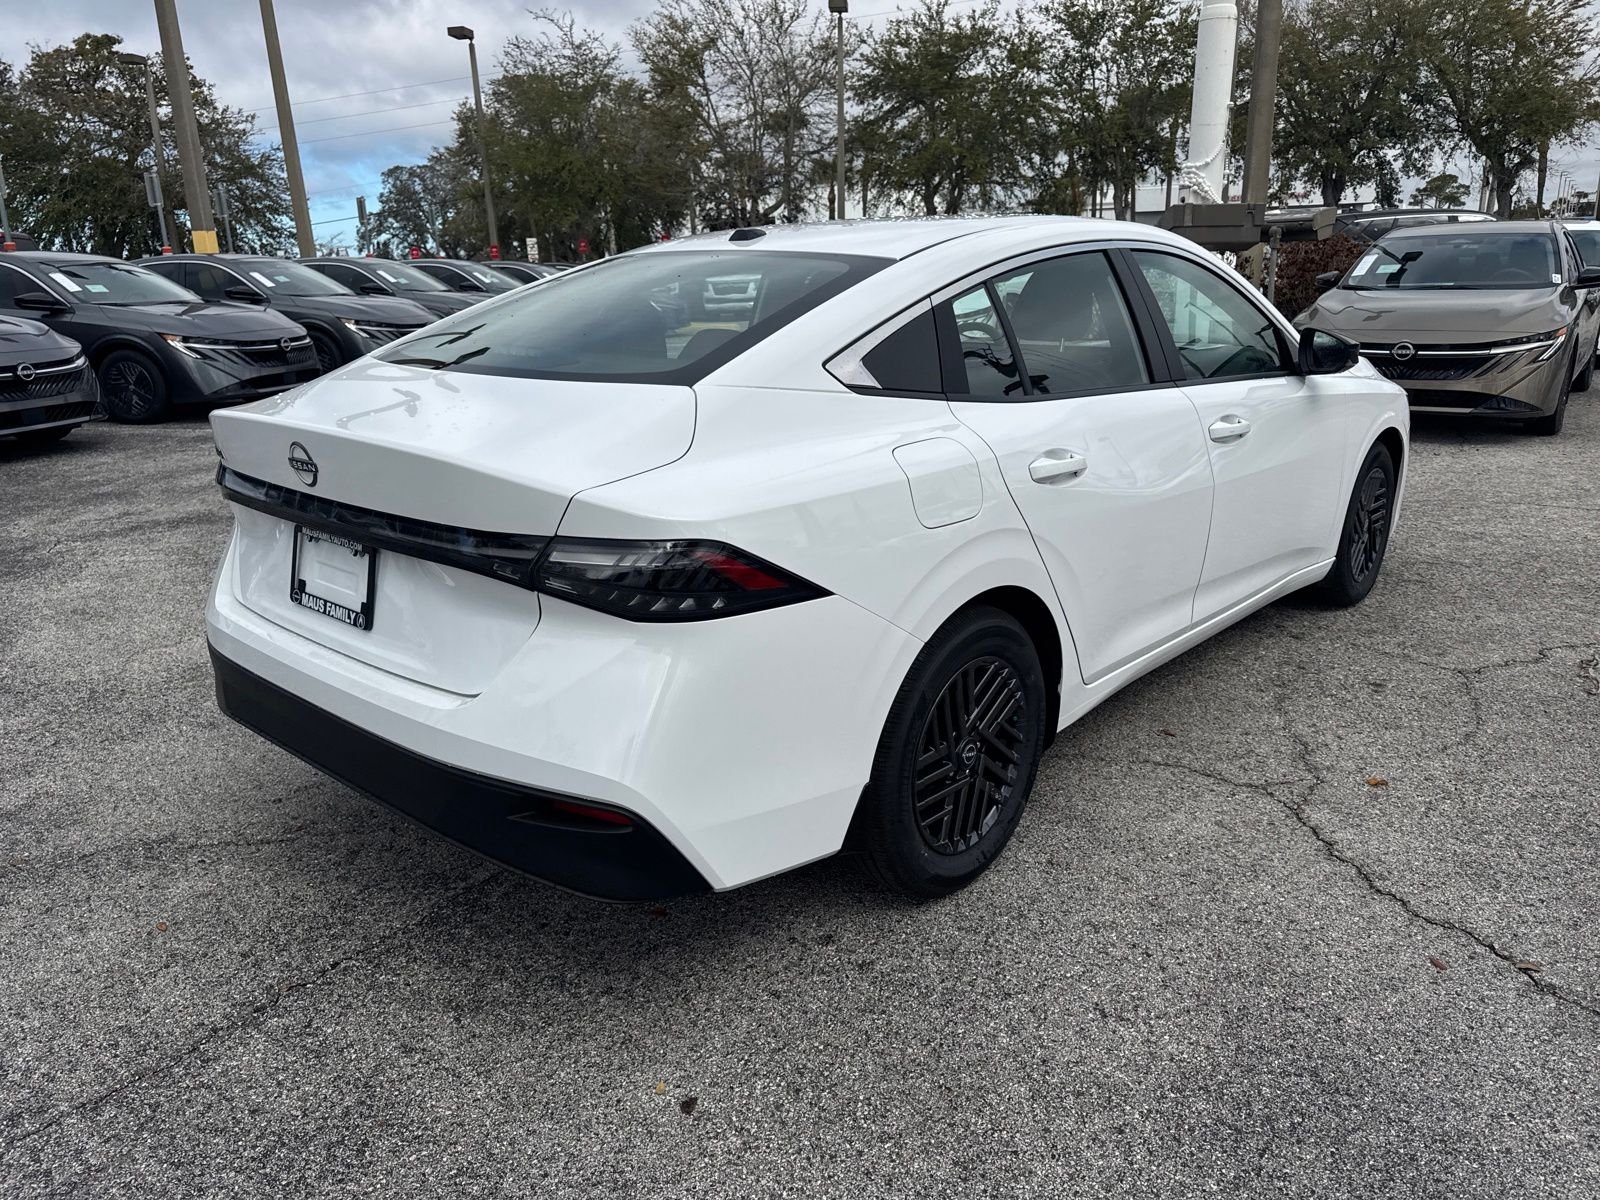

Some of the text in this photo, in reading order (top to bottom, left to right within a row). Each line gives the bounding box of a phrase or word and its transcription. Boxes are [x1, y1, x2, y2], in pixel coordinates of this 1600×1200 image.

[289, 459, 316, 472] SSAN
[302, 526, 363, 551] MAUSFAMILYAUTO.COM
[301, 592, 356, 625] MAUS FAMILY
